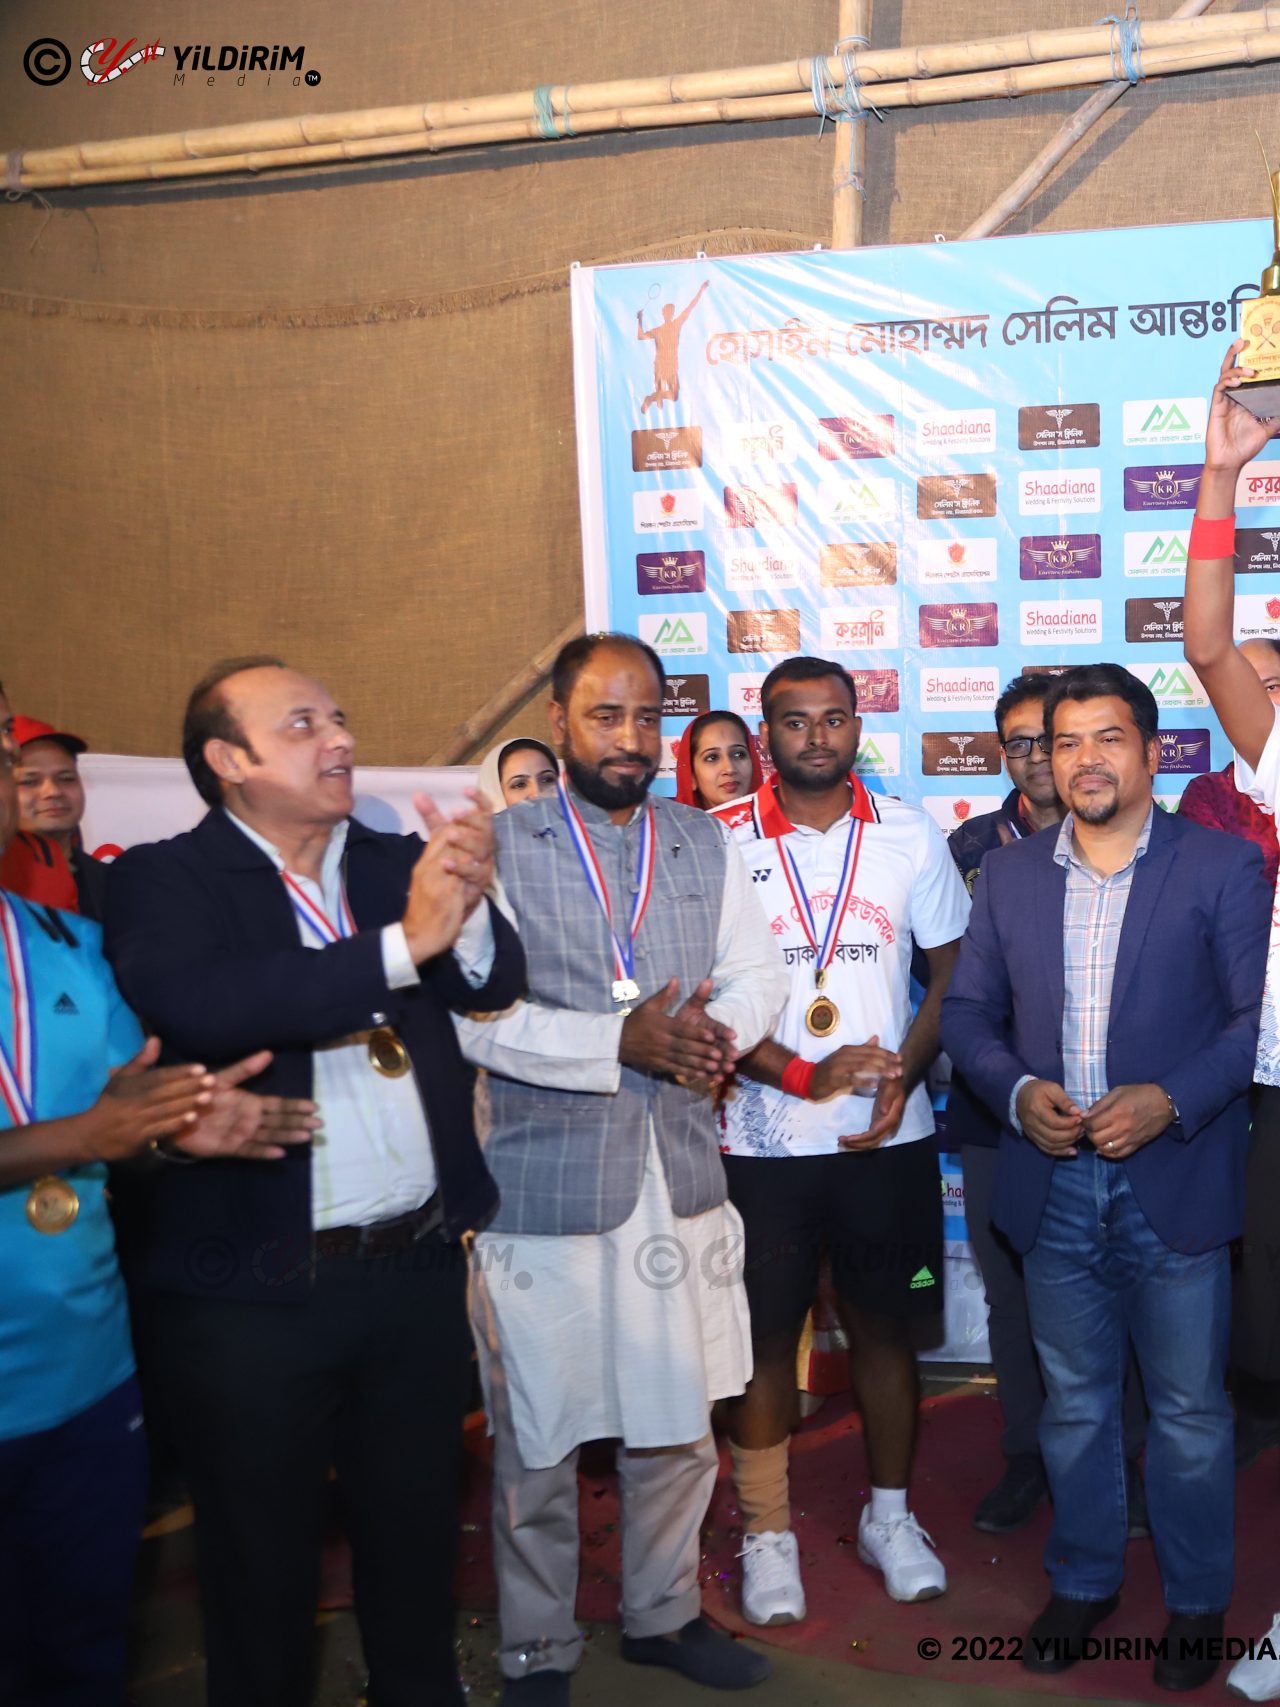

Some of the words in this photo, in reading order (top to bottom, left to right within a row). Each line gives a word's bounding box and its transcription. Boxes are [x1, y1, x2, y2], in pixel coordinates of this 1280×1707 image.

[845, 314, 990, 355] মোহাম্মদ
[1002, 295, 1116, 347] সেলিম
[922, 419, 991, 435] Shaadiana
[1025, 478, 1095, 495] Shaadiana
[1025, 497, 1046, 505] Wedding
[1052, 496, 1072, 504] Festivity
[1026, 609, 1096, 625] Shaadiana
[1053, 626, 1073, 634] Festivity
[926, 677, 993, 692] Shaadiana
[952, 693, 972, 701] Festivity
[910, 1279, 935, 1289] adidas
